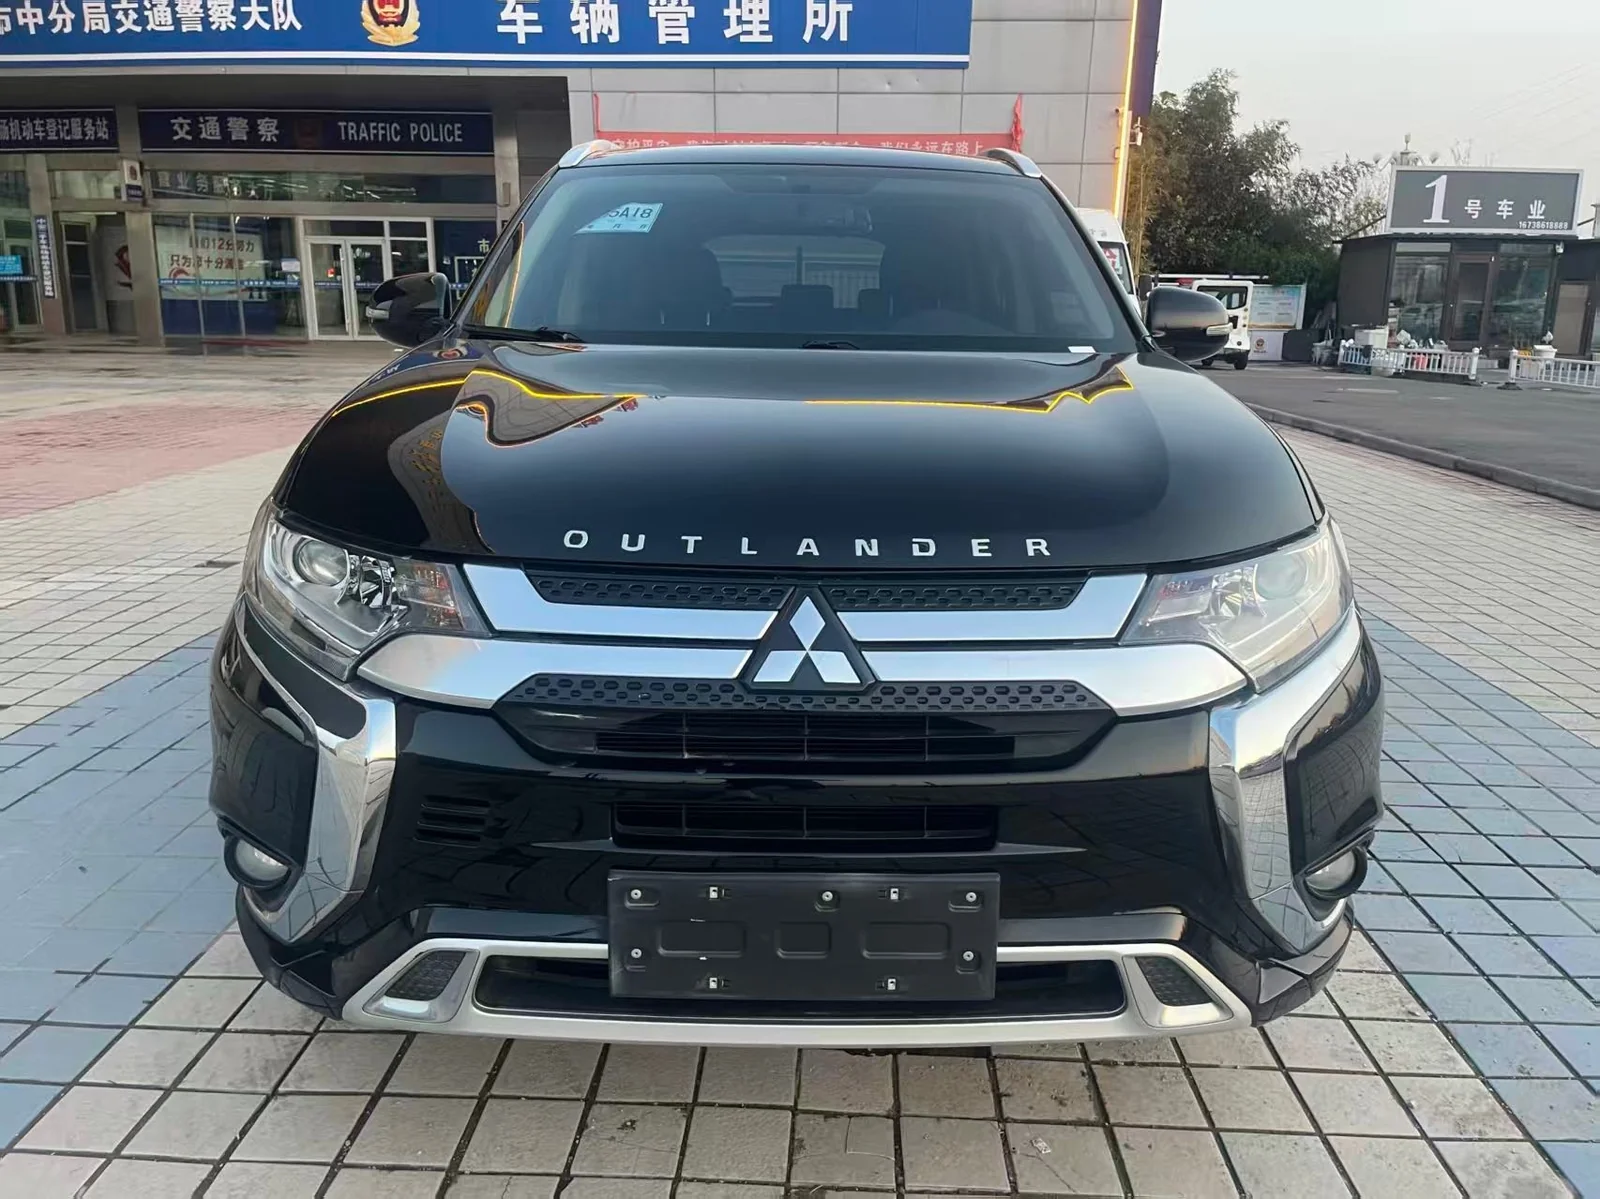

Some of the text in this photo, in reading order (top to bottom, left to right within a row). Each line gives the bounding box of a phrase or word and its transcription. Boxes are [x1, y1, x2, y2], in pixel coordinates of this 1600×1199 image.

[496, 0, 854, 45] 车辆管理所
[170, 116, 280, 142] 交通警察
[337, 121, 463, 142] TRAFFIC POLICE
[563, 529, 1051, 557] OUTLANDER
